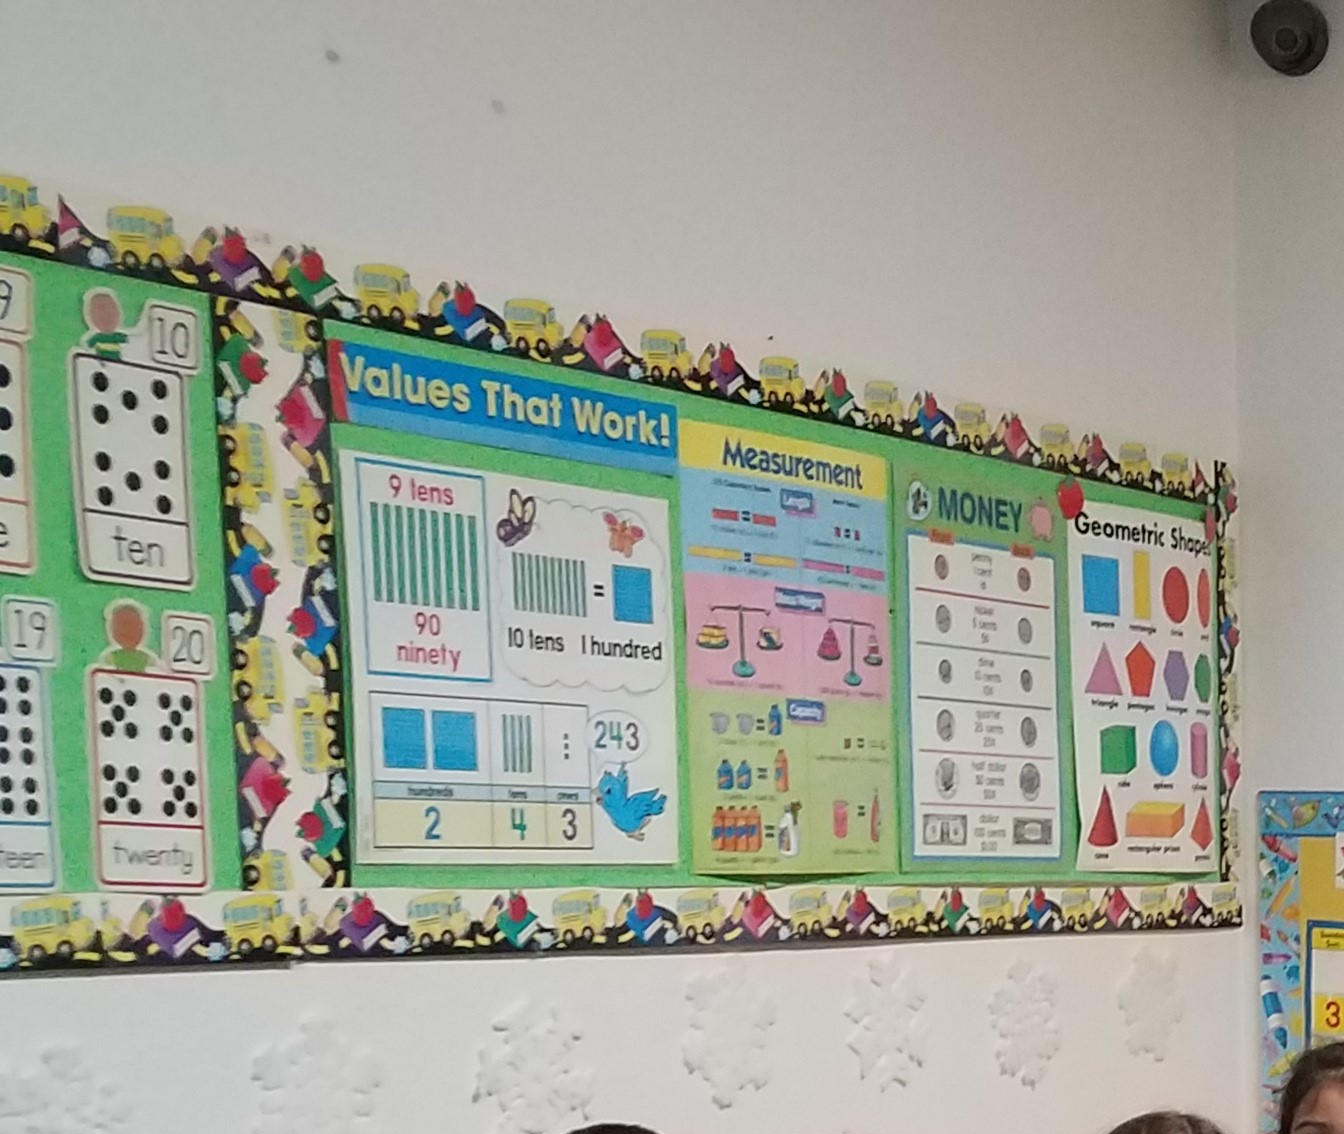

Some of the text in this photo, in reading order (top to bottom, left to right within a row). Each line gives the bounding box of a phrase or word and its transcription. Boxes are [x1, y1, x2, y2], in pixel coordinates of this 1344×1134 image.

[156, 316, 190, 359] 10
[339, 351, 671, 448] Values That Work!
[722, 437, 864, 490] Measurement
[388, 474, 455, 506] 9 tens
[938, 486, 1023, 534] MONEY
[111, 526, 165, 568] ten
[1074, 511, 1166, 549] Geometric
[13, 608, 47, 650] 19
[414, 611, 442, 637] 90
[507, 627, 566, 653] 10 tens
[171, 625, 205, 665] 20
[395, 640, 462, 672] ninety
[589, 635, 664, 661] hundred
[593, 719, 641, 752] 243
[424, 804, 442, 841] 2
[510, 806, 528, 841] 4
[561, 808, 579, 842] 3
[112, 840, 194, 876] twenty
[1325, 1001, 1341, 1028] 3
